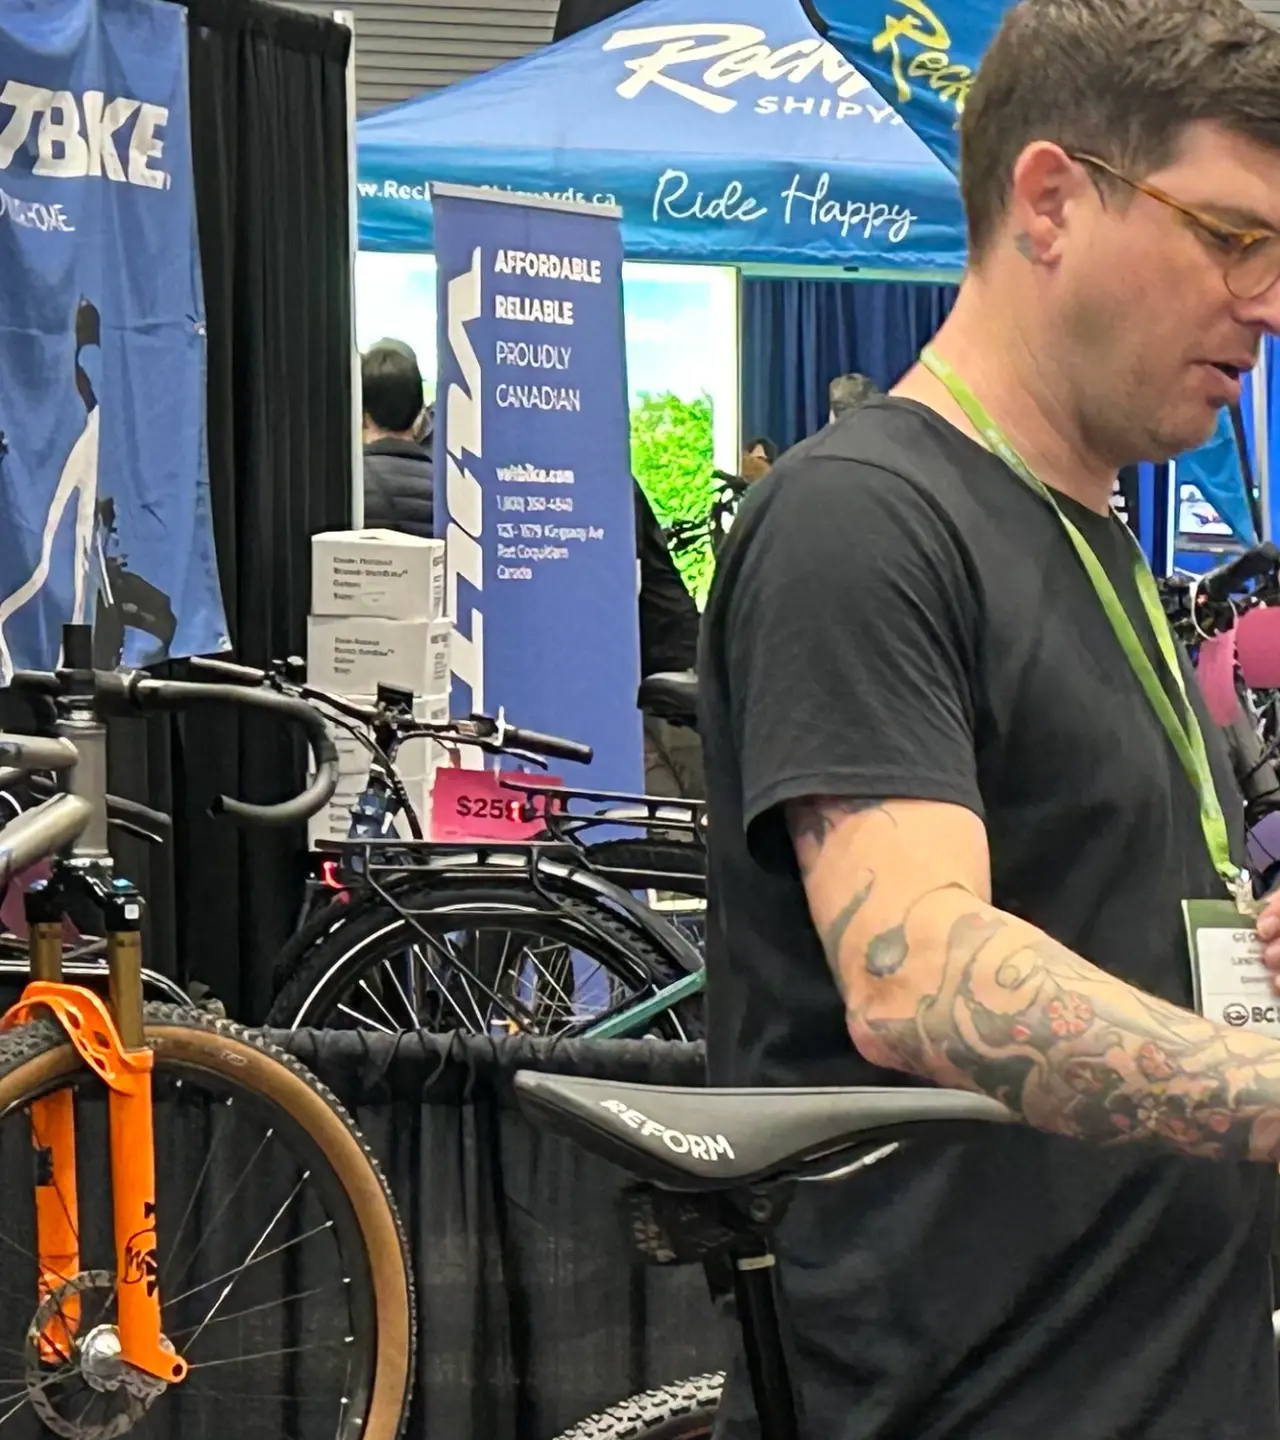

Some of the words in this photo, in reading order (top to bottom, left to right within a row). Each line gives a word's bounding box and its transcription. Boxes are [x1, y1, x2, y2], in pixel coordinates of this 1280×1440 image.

[653, 169, 769, 222] Ride
[781, 172, 919, 243] Happy
[494, 249, 602, 284] AFFORDABLE
[495, 295, 574, 325] RELIABLE
[496, 341, 572, 370] PROUDLY
[496, 384, 580, 412] CANADIAN
[1252, 1006, 1275, 1023] BC
[600, 1099, 735, 1162] REFORM
